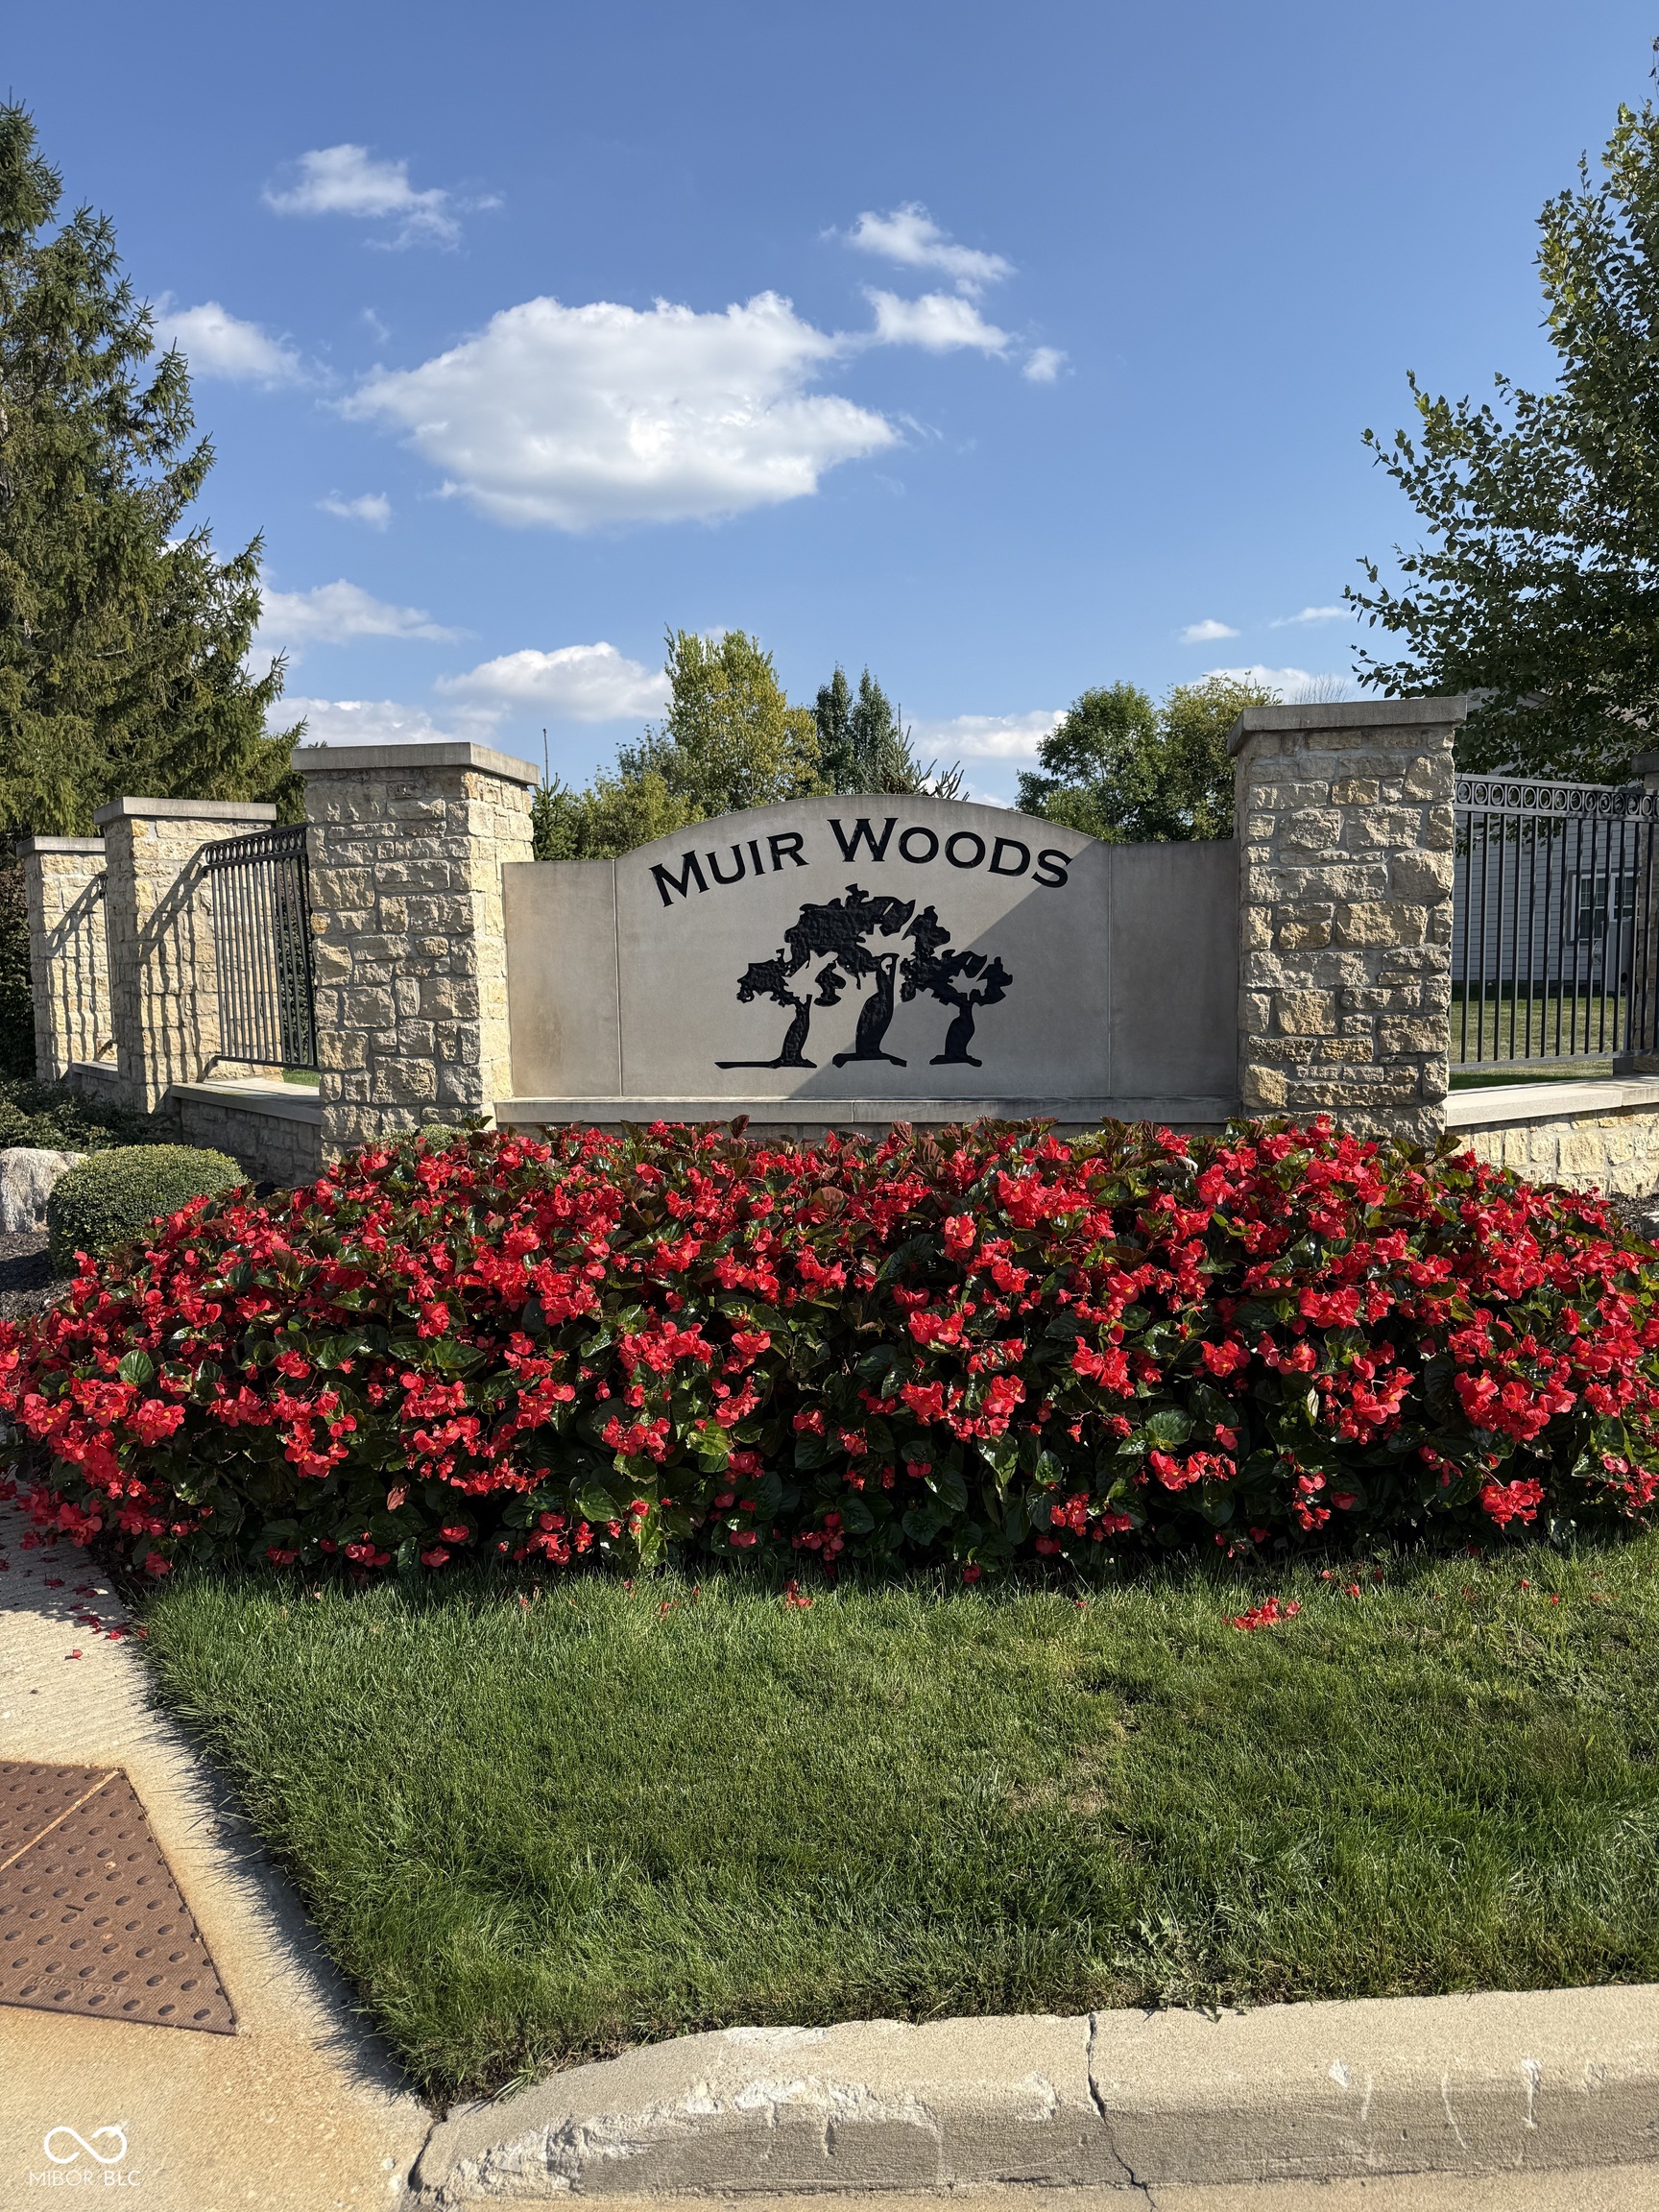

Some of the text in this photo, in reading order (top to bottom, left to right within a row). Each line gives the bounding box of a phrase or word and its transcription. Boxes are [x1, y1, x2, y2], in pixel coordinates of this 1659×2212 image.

[649, 817, 1074, 907] MUIR WOODS
[31, 1977, 71, 1988] MADE
[73, 1981, 88, 1991] IN
